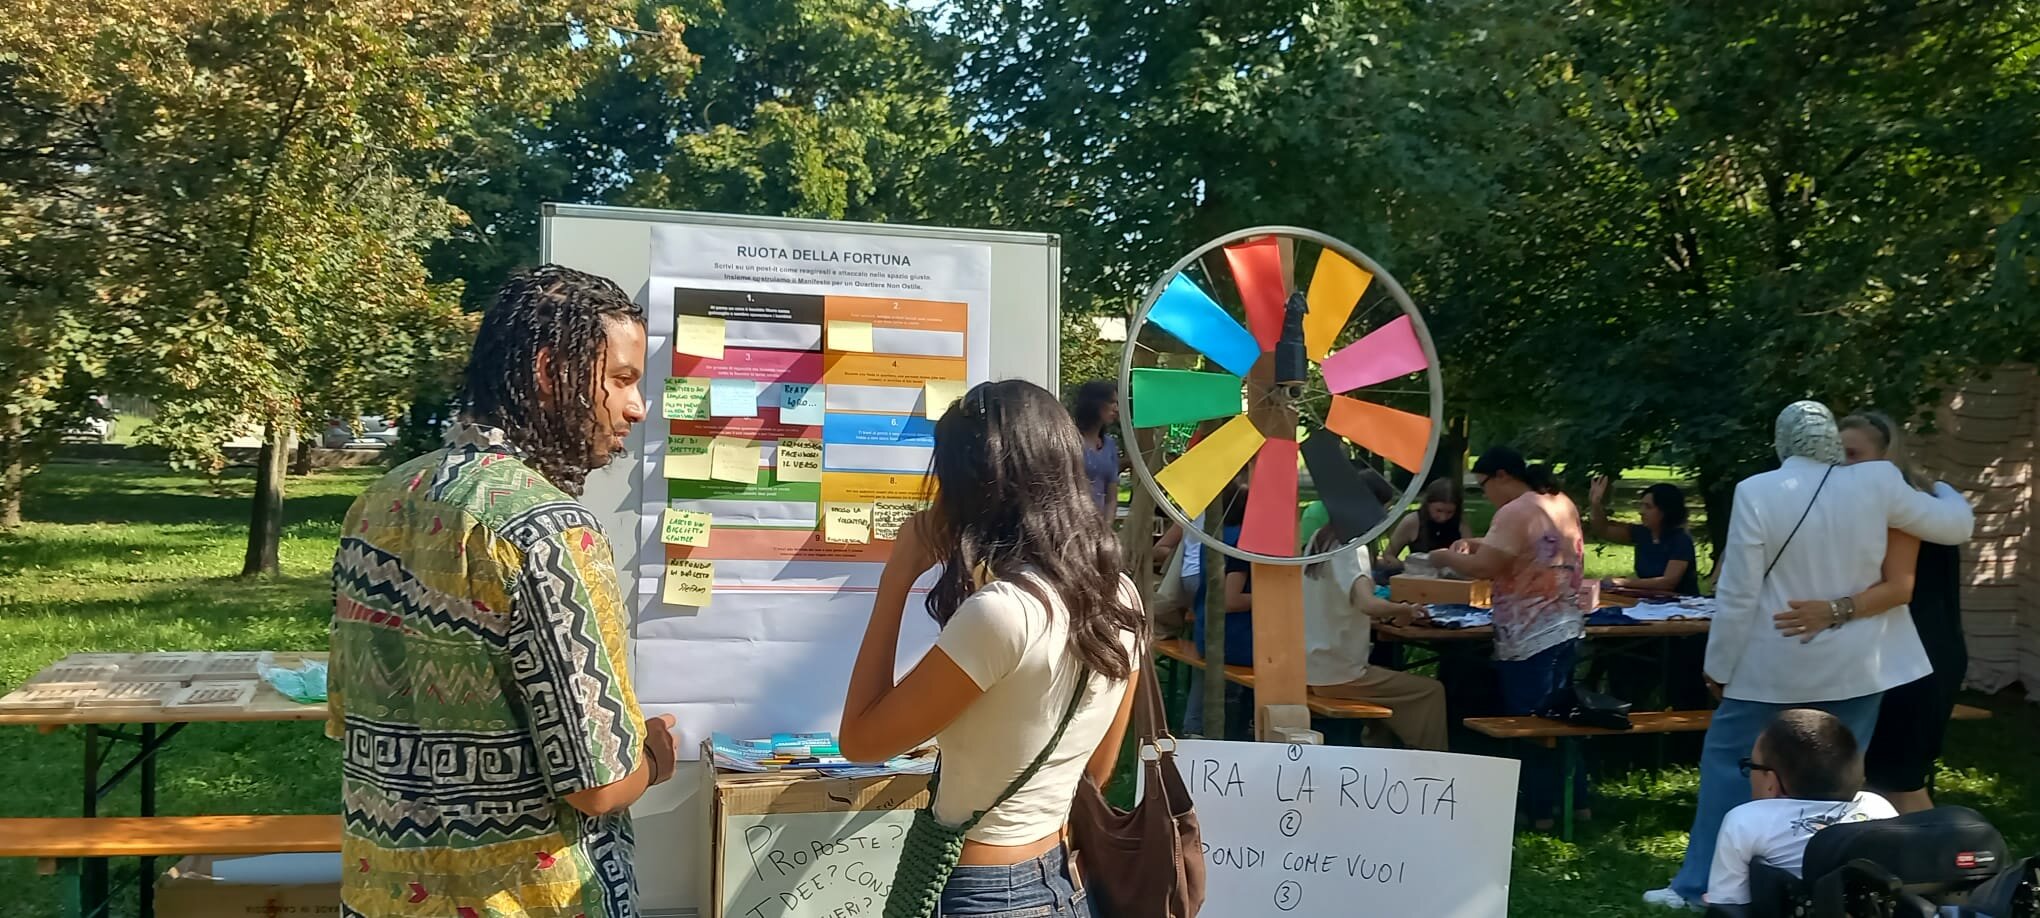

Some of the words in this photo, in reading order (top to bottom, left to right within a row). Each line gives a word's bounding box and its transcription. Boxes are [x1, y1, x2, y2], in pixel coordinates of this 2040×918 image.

[737, 246, 788, 260] RUOTA
[792, 249, 839, 263] DELLA
[844, 252, 911, 266] FORTUNA
[724, 273, 751, 281] Insieme
[798, 278, 830, 286] Manifesto
[1171, 754, 1245, 798] IRA
[1277, 765, 1315, 804] LA
[1340, 766, 1458, 820] RUOTA
[1283, 852, 1338, 873] COME
[1347, 854, 1405, 884] VUOI
